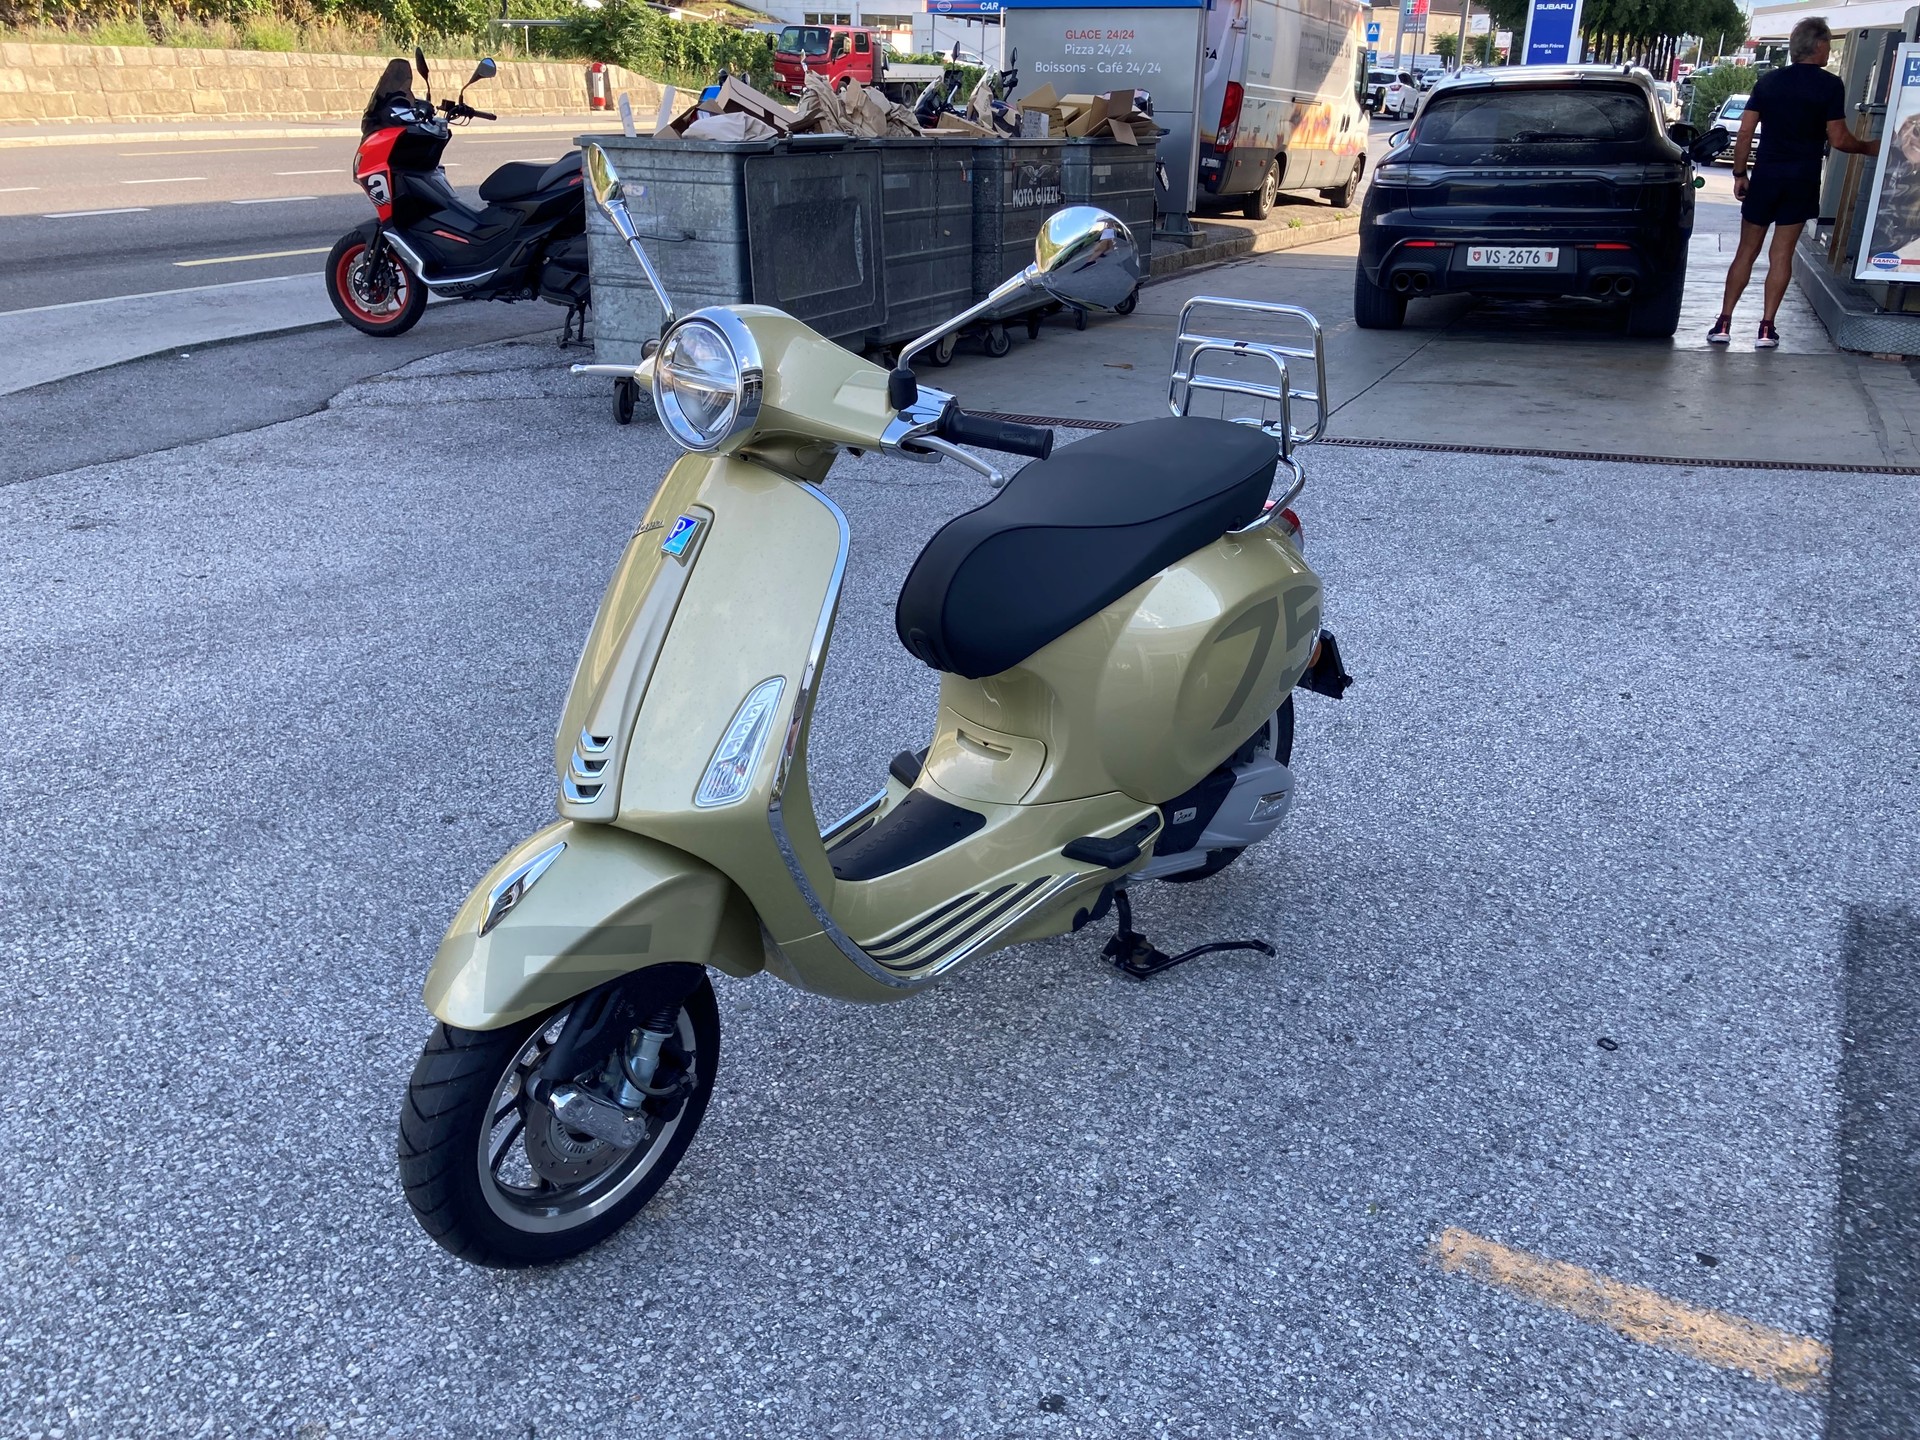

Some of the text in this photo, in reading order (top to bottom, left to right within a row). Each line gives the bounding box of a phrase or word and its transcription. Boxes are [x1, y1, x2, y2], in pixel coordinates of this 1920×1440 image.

[980, 2, 999, 10] CAR
[1065, 30, 1135, 40] GLACE 24/24
[1859, 29, 1869, 40] 4
[1064, 43, 1132, 57] Pizza 24/24
[1035, 61, 1086, 73] Boissons
[1096, 61, 1123, 73] Café
[1126, 62, 1161, 75] 24/24
[1012, 186, 1058, 208] MOTO GUZZI
[1211, 585, 1321, 731] 75
